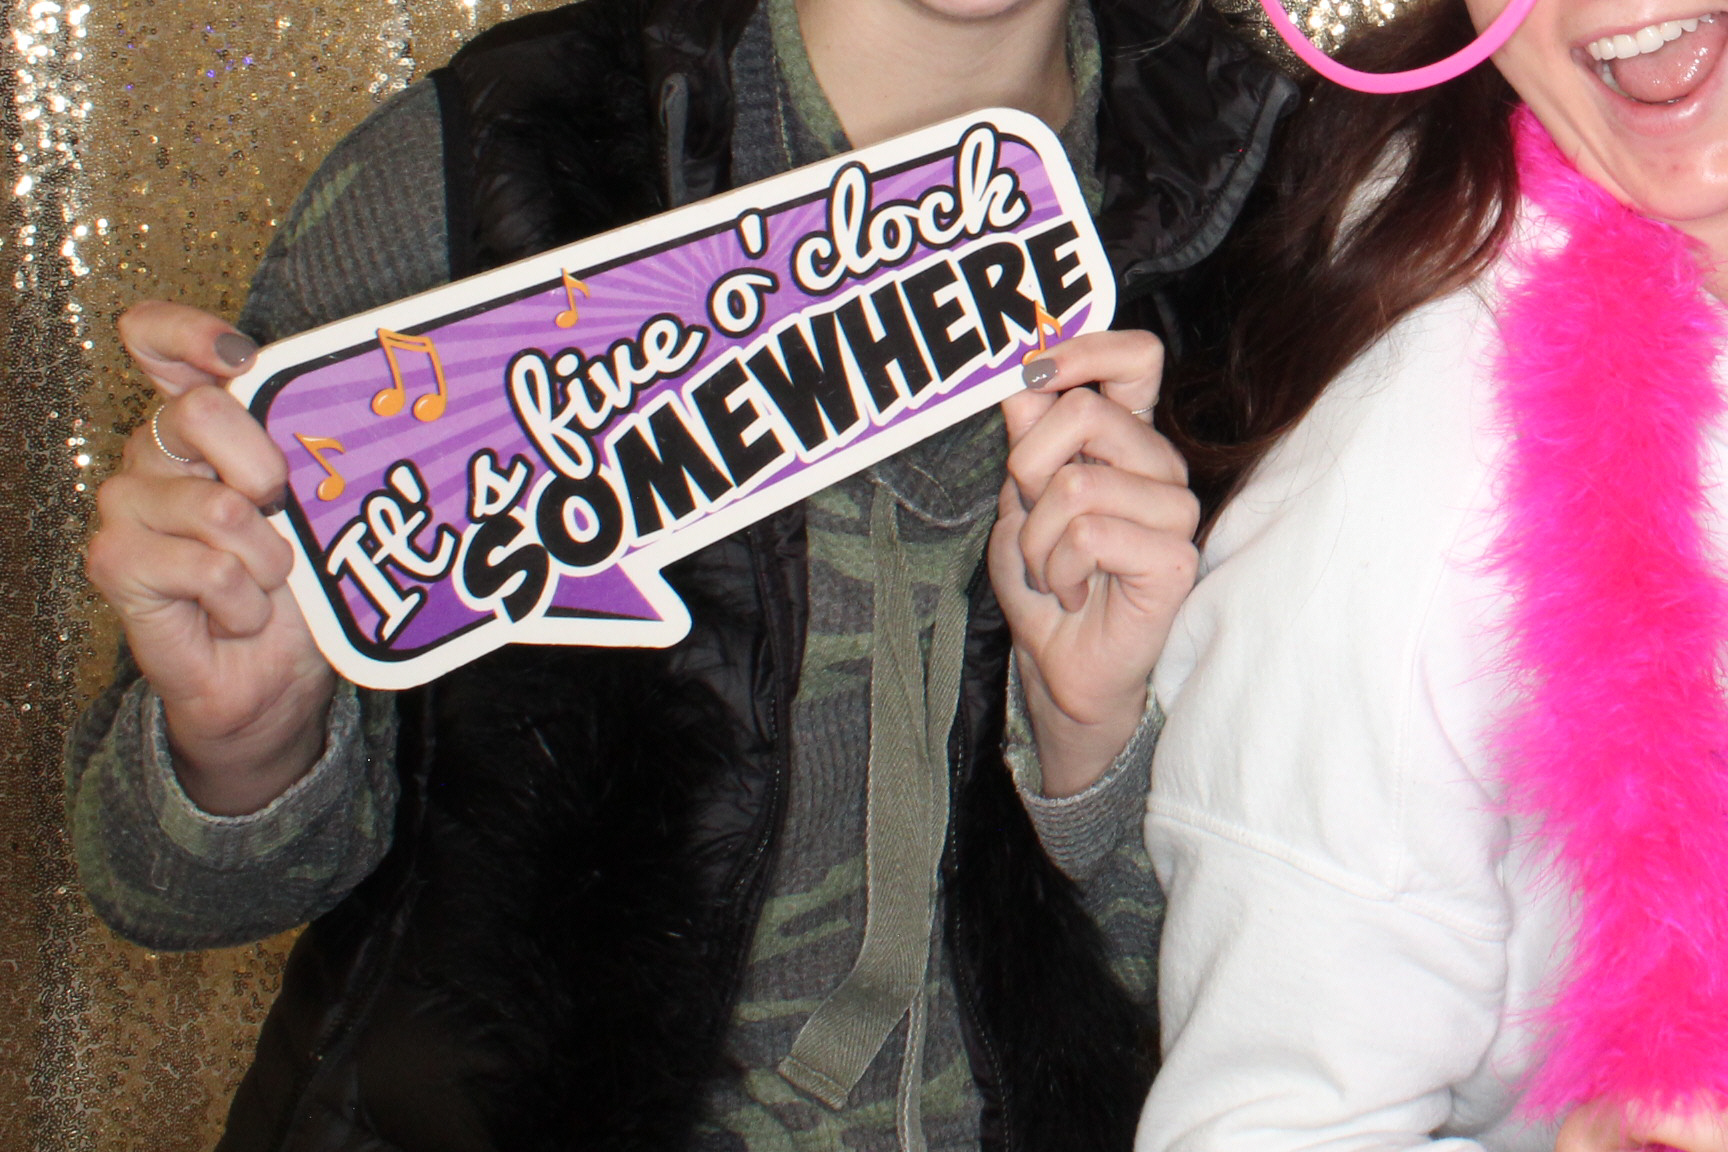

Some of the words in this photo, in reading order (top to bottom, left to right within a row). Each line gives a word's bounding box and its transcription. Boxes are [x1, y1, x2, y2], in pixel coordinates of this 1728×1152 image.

[326, 452, 527, 641] It's
[511, 318, 704, 480] five
[461, 220, 1094, 624] SOMEWHERE
